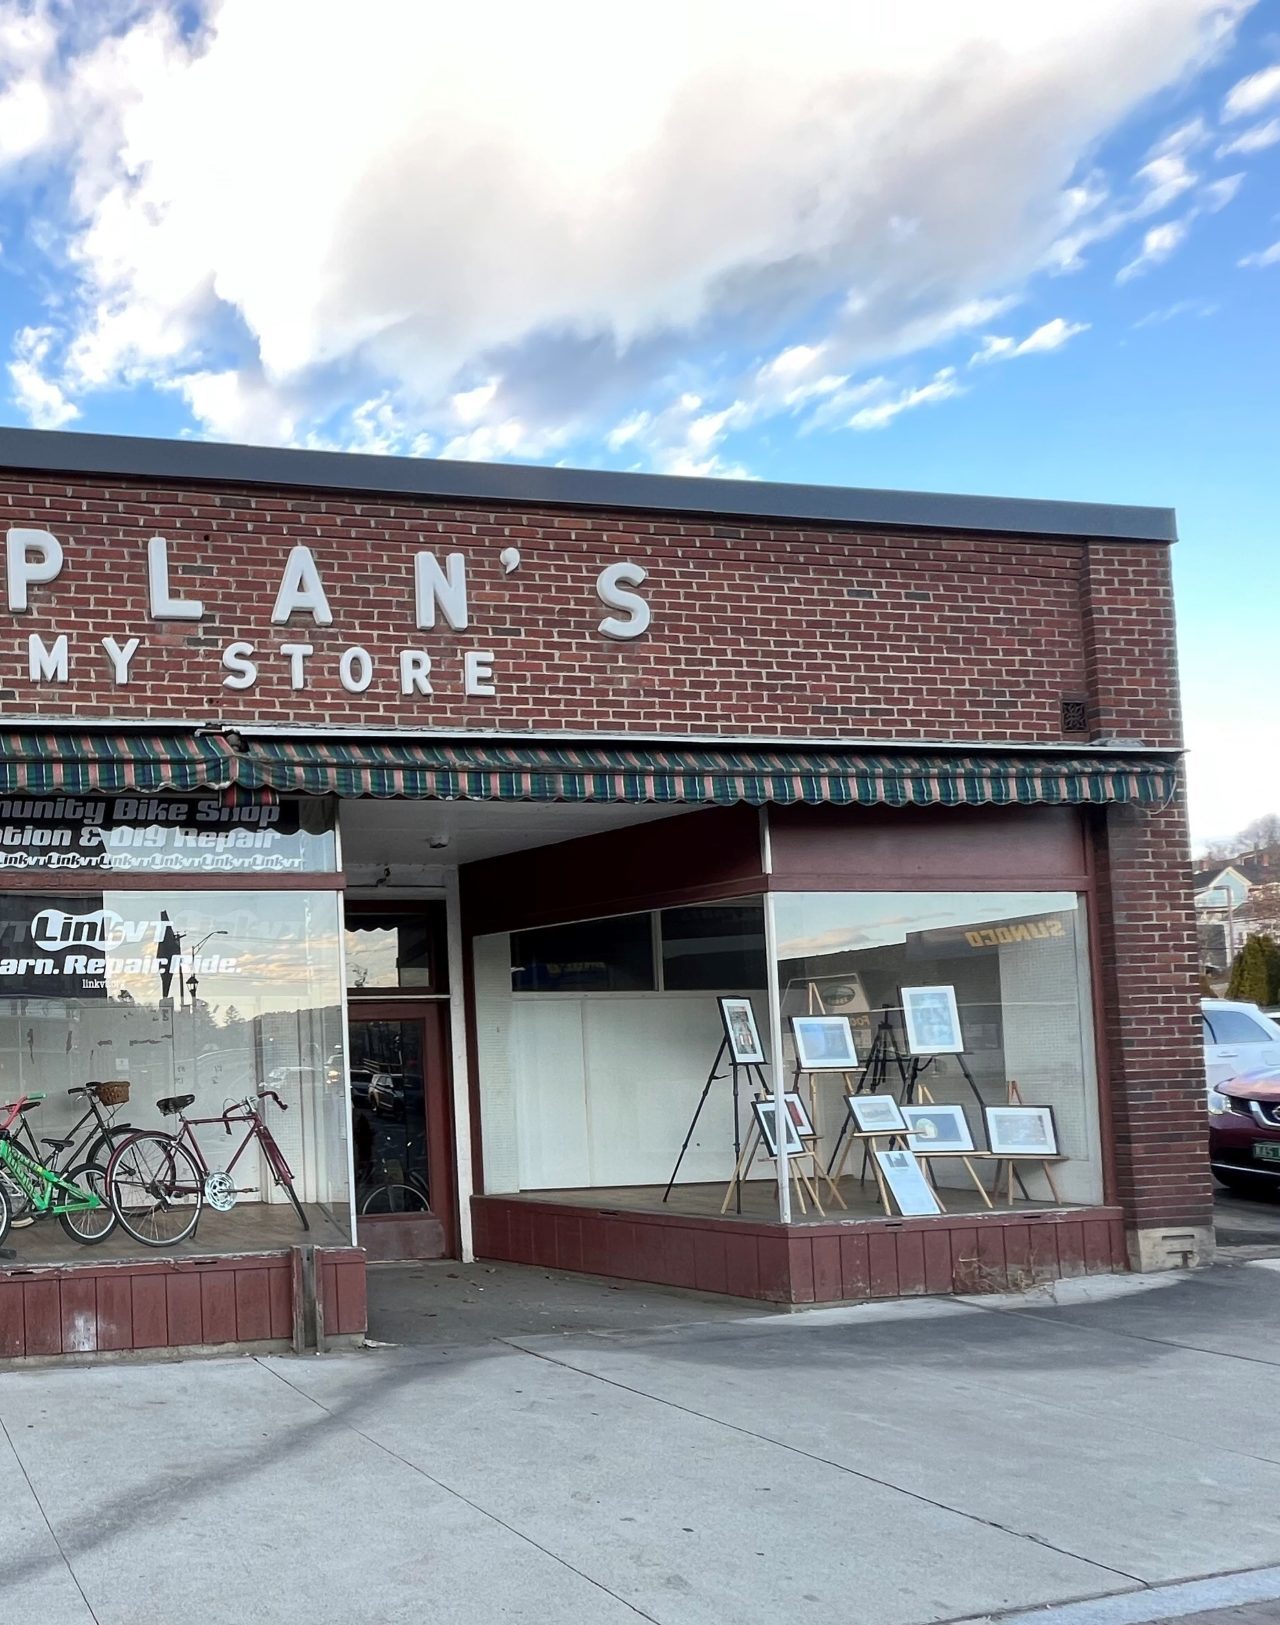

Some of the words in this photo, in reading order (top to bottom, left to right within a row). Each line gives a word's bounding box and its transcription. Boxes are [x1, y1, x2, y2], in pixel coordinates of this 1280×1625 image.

[222, 641, 496, 697] STORE
[112, 798, 189, 821] Bike
[79, 826, 102, 847] &
[173, 826, 282, 853] Repair
